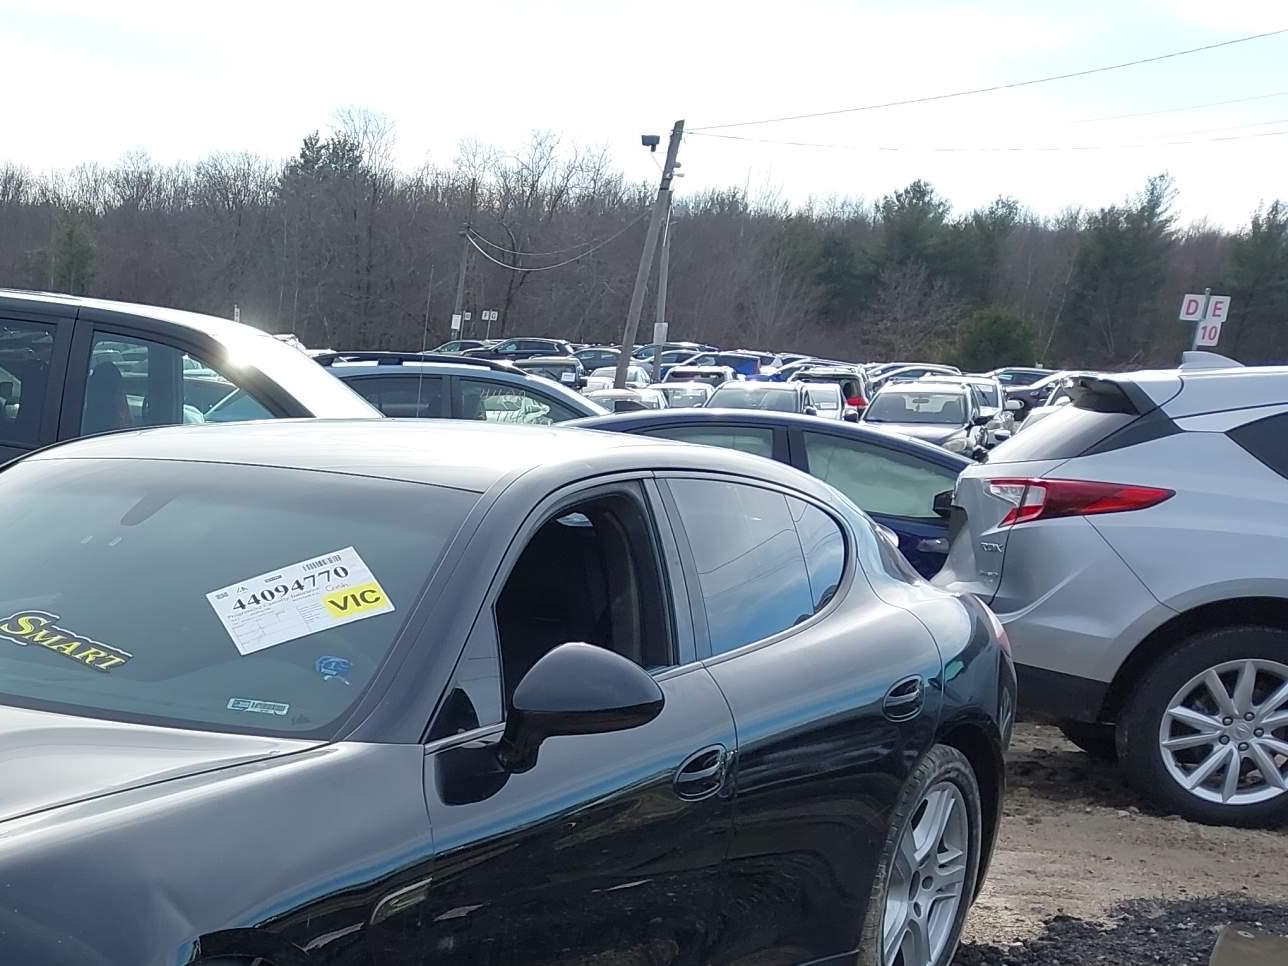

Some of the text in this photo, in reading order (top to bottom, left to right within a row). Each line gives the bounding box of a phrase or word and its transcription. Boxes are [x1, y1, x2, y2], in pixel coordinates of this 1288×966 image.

[1185, 299, 1199, 316] D
[1211, 300, 1225, 318] E
[1200, 325, 1219, 341] 10
[232, 566, 349, 612] 44094770
[328, 588, 381, 612] VIC
